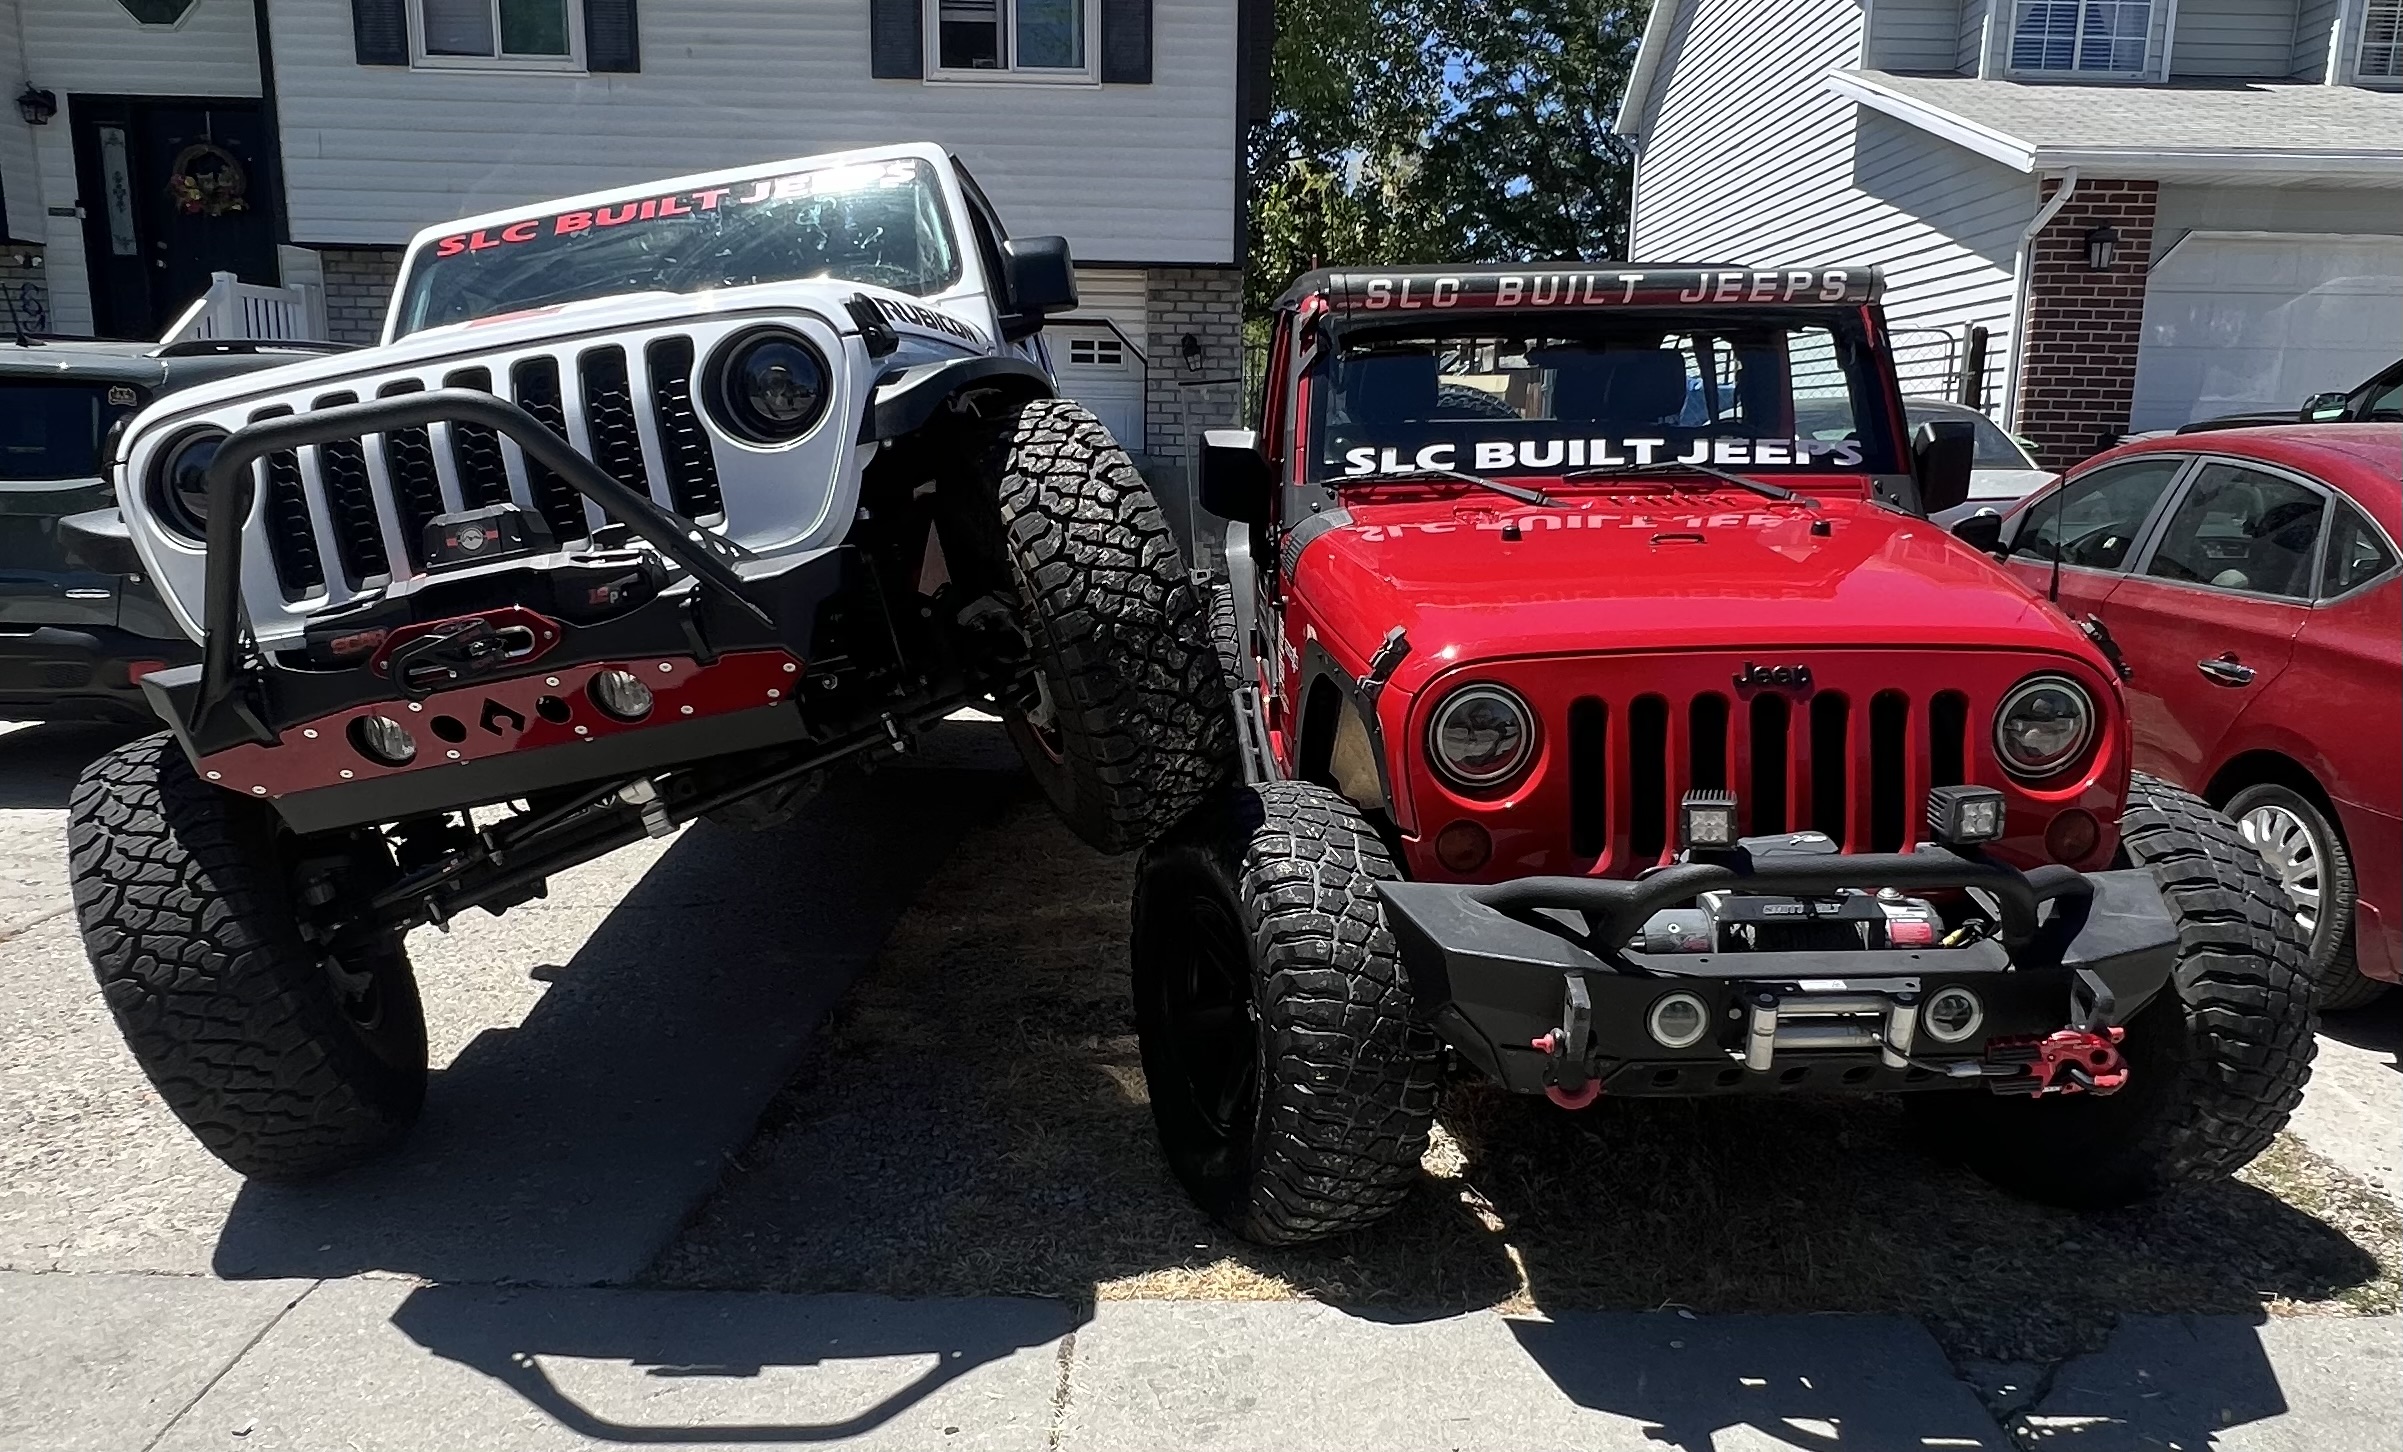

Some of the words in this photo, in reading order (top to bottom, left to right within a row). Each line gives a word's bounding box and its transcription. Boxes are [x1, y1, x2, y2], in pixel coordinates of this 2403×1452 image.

[436, 220, 540, 257] SLC
[554, 188, 730, 236] BUILT
[739, 158, 916, 203] JES
[1365, 277, 1460, 309] SLC
[1495, 274, 1644, 307] BUILT
[1680, 270, 1848, 303] JEEPS
[871, 297, 980, 345] RUBICON
[1344, 443, 1457, 475] SLC
[1475, 438, 1665, 469] BUILT
[1677, 438, 1864, 466] JEEPS
[1732, 660, 1812, 690] Jeep
